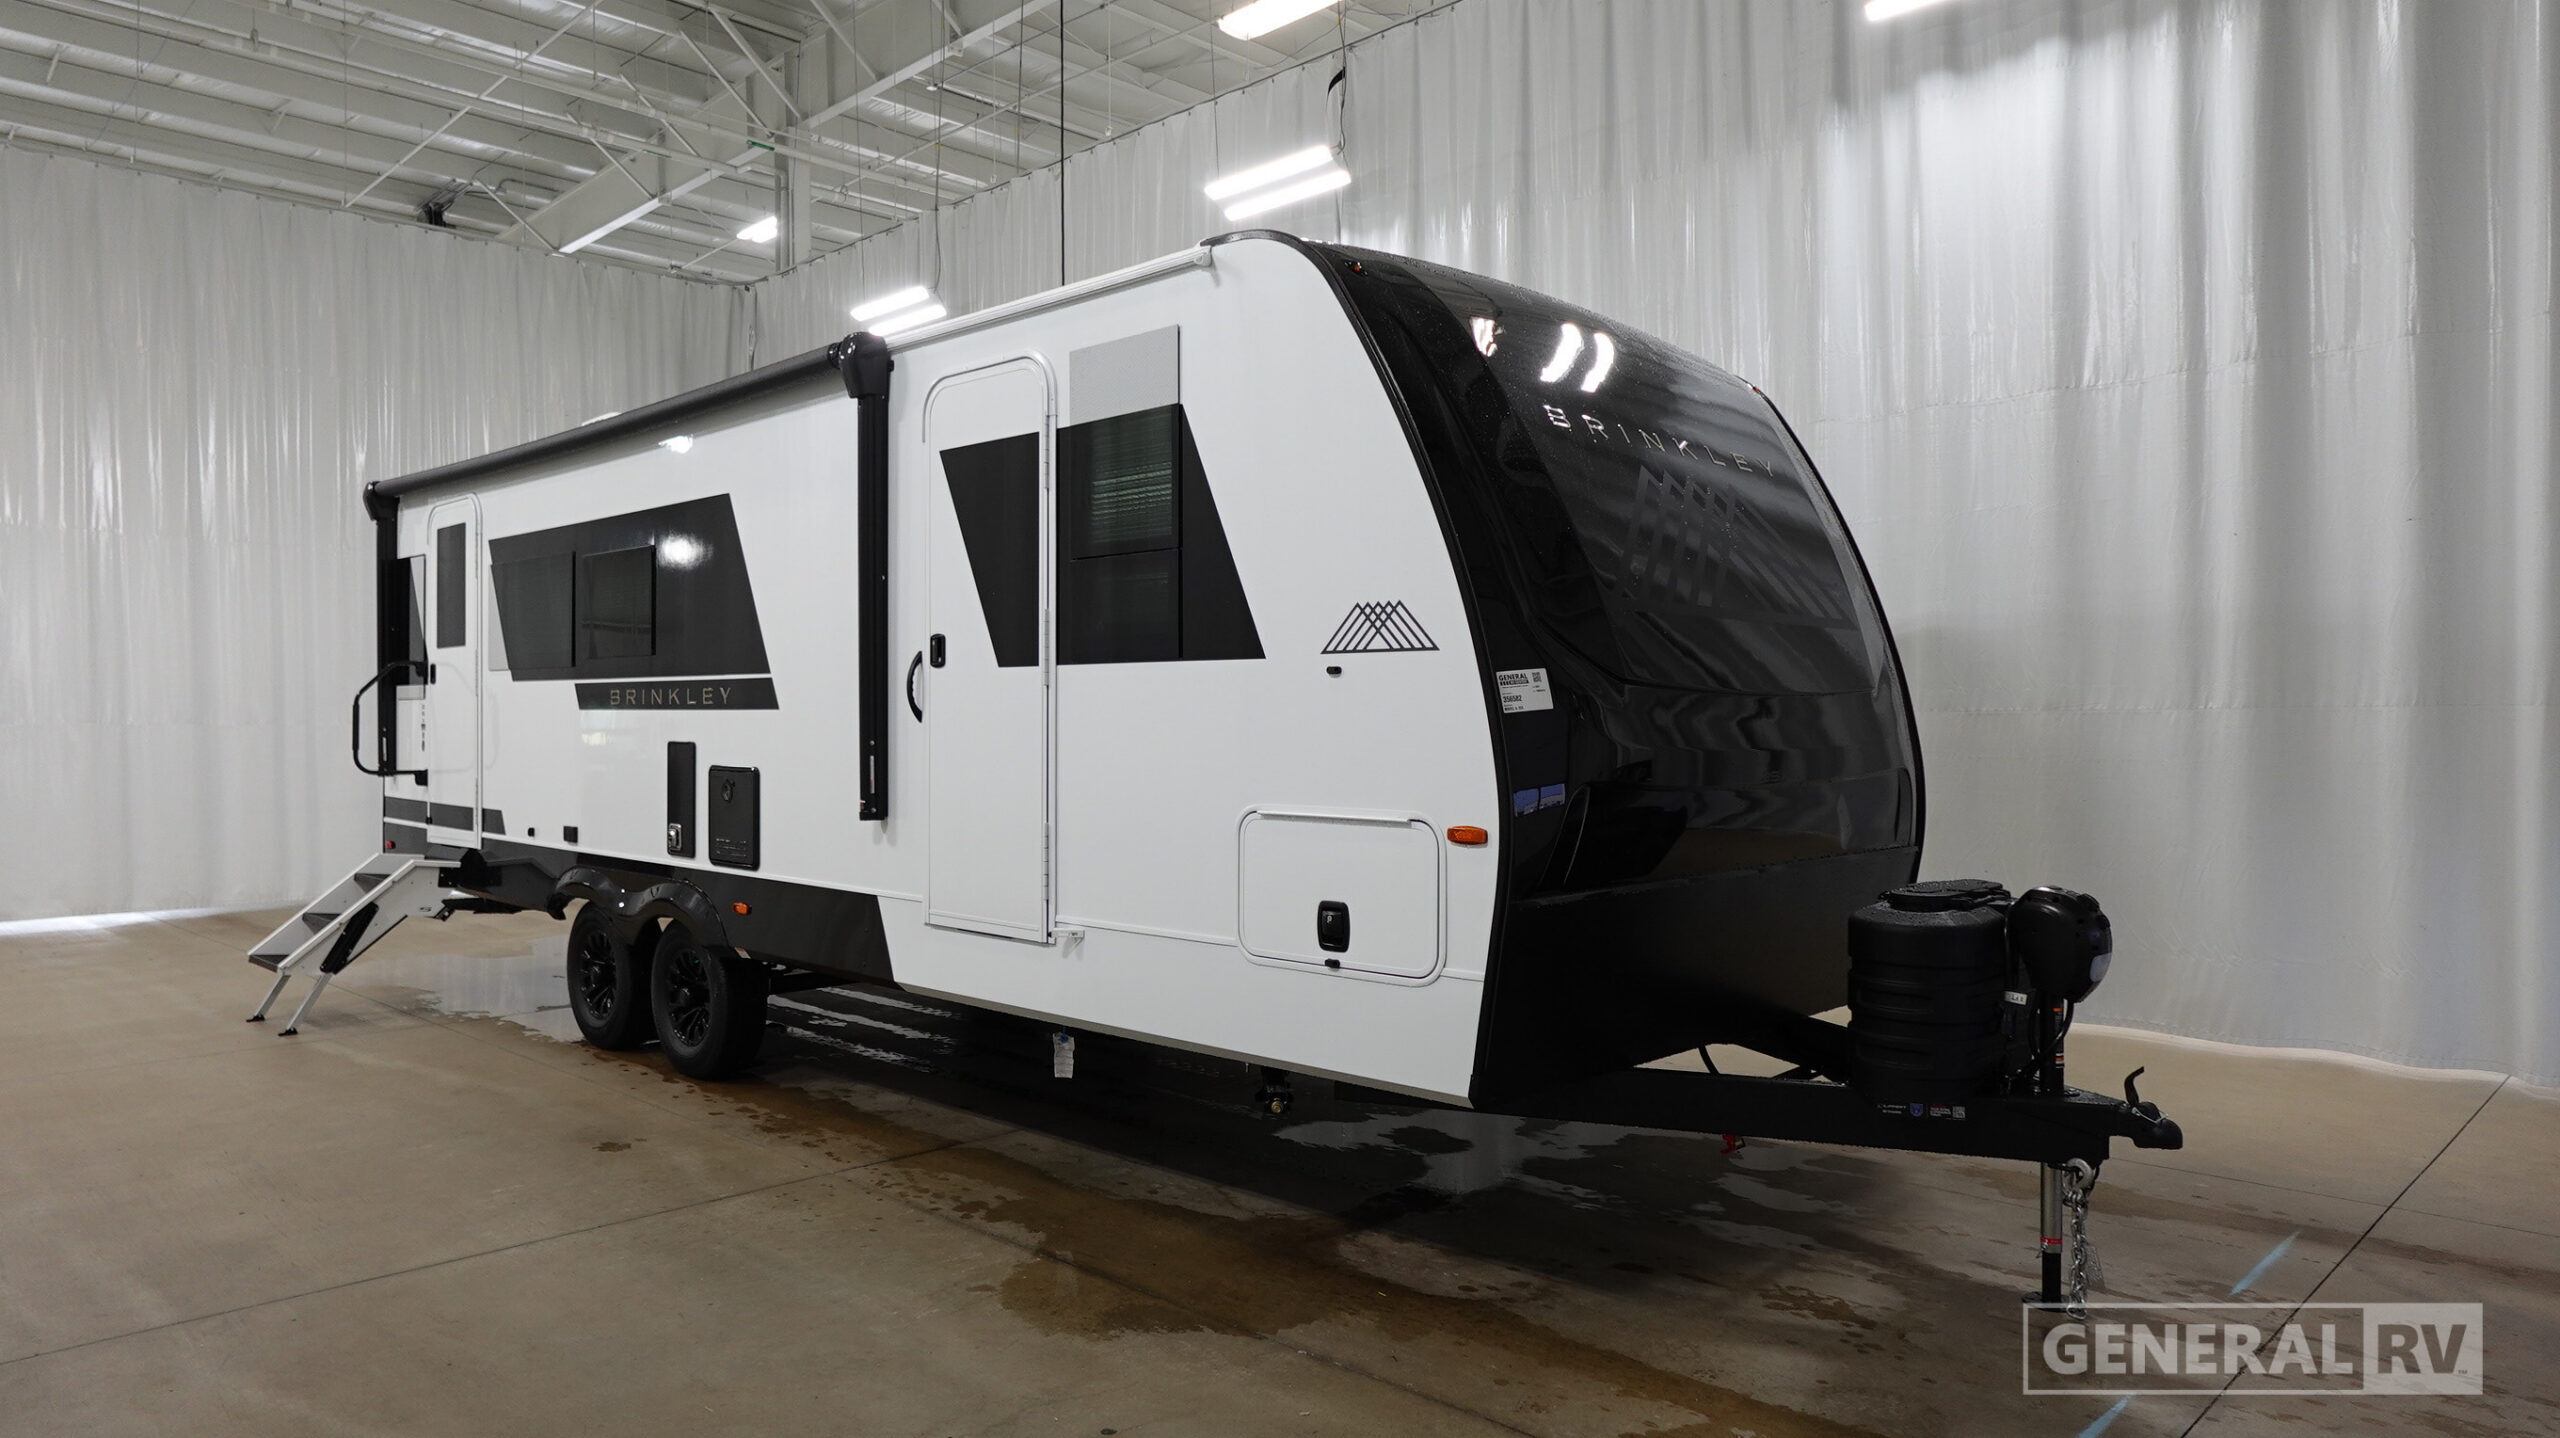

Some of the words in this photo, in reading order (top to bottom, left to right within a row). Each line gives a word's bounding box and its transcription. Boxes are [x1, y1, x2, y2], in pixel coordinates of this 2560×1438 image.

[1543, 404, 1773, 477] BRINKLEY
[1498, 672, 1528, 681] GENERAL
[610, 686, 731, 705] BRINKLEY
